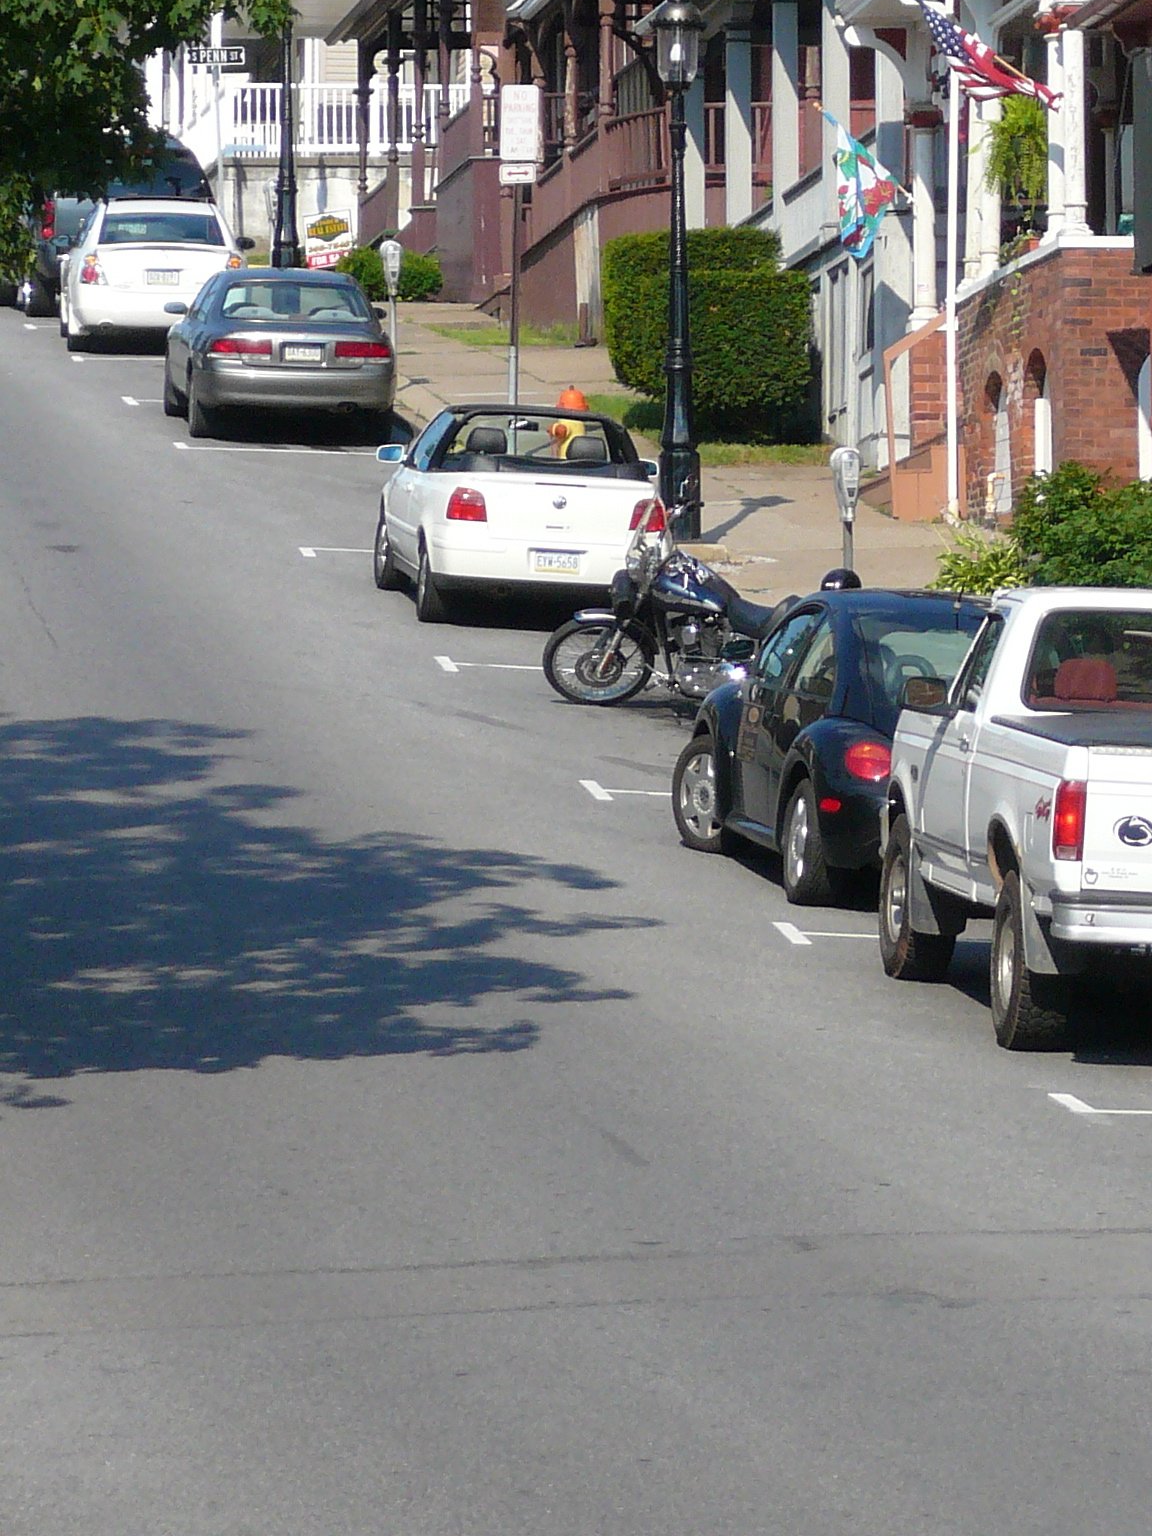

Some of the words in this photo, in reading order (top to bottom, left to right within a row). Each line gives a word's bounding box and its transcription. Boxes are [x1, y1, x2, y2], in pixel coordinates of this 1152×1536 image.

[191, 51, 198, 62] S
[200, 49, 228, 63] PENN
[229, 51, 239, 61] ST
